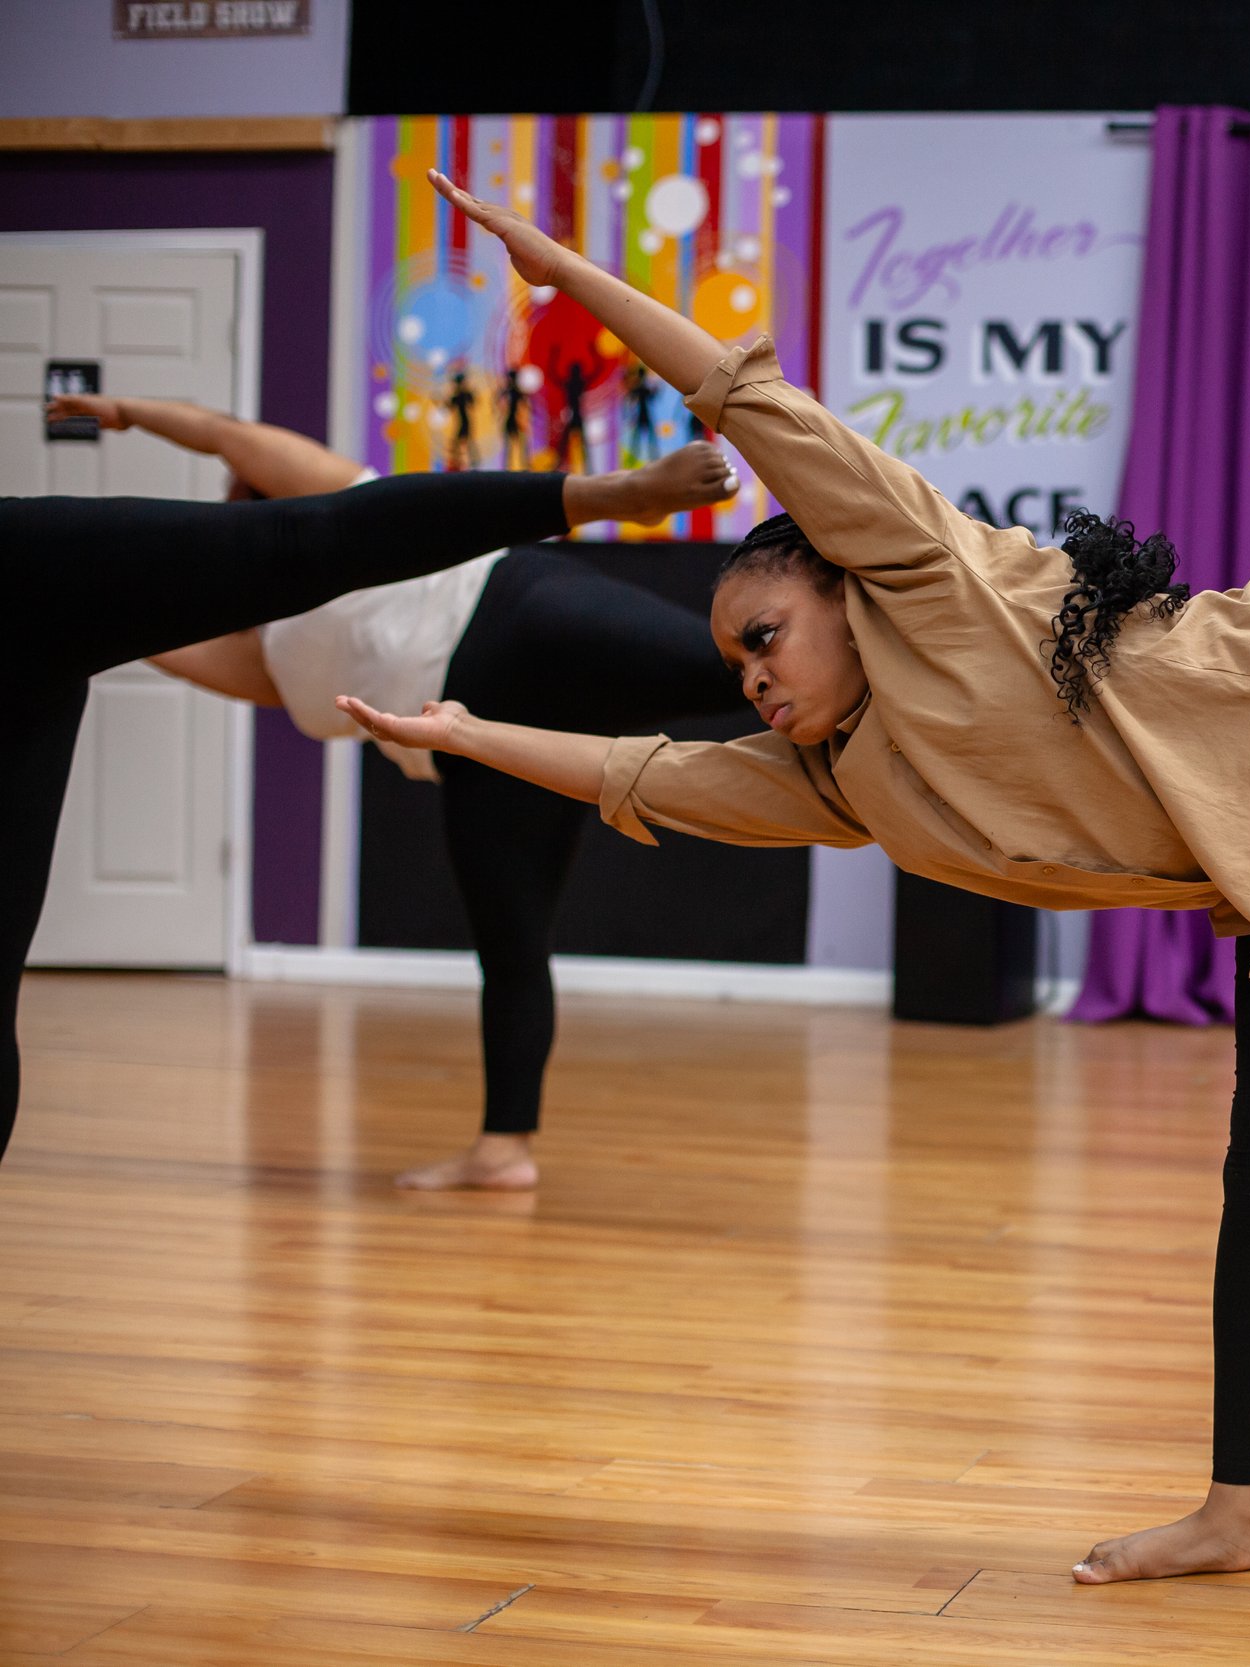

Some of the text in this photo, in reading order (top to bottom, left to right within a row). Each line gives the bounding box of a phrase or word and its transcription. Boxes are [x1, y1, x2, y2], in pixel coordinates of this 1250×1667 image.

[128, 0, 298, 31] FIELD SHOW
[845, 203, 1143, 310] Together
[864, 318, 1127, 375] IS MY
[846, 388, 1109, 456] Favorite
[955, 486, 1085, 533] ACE
